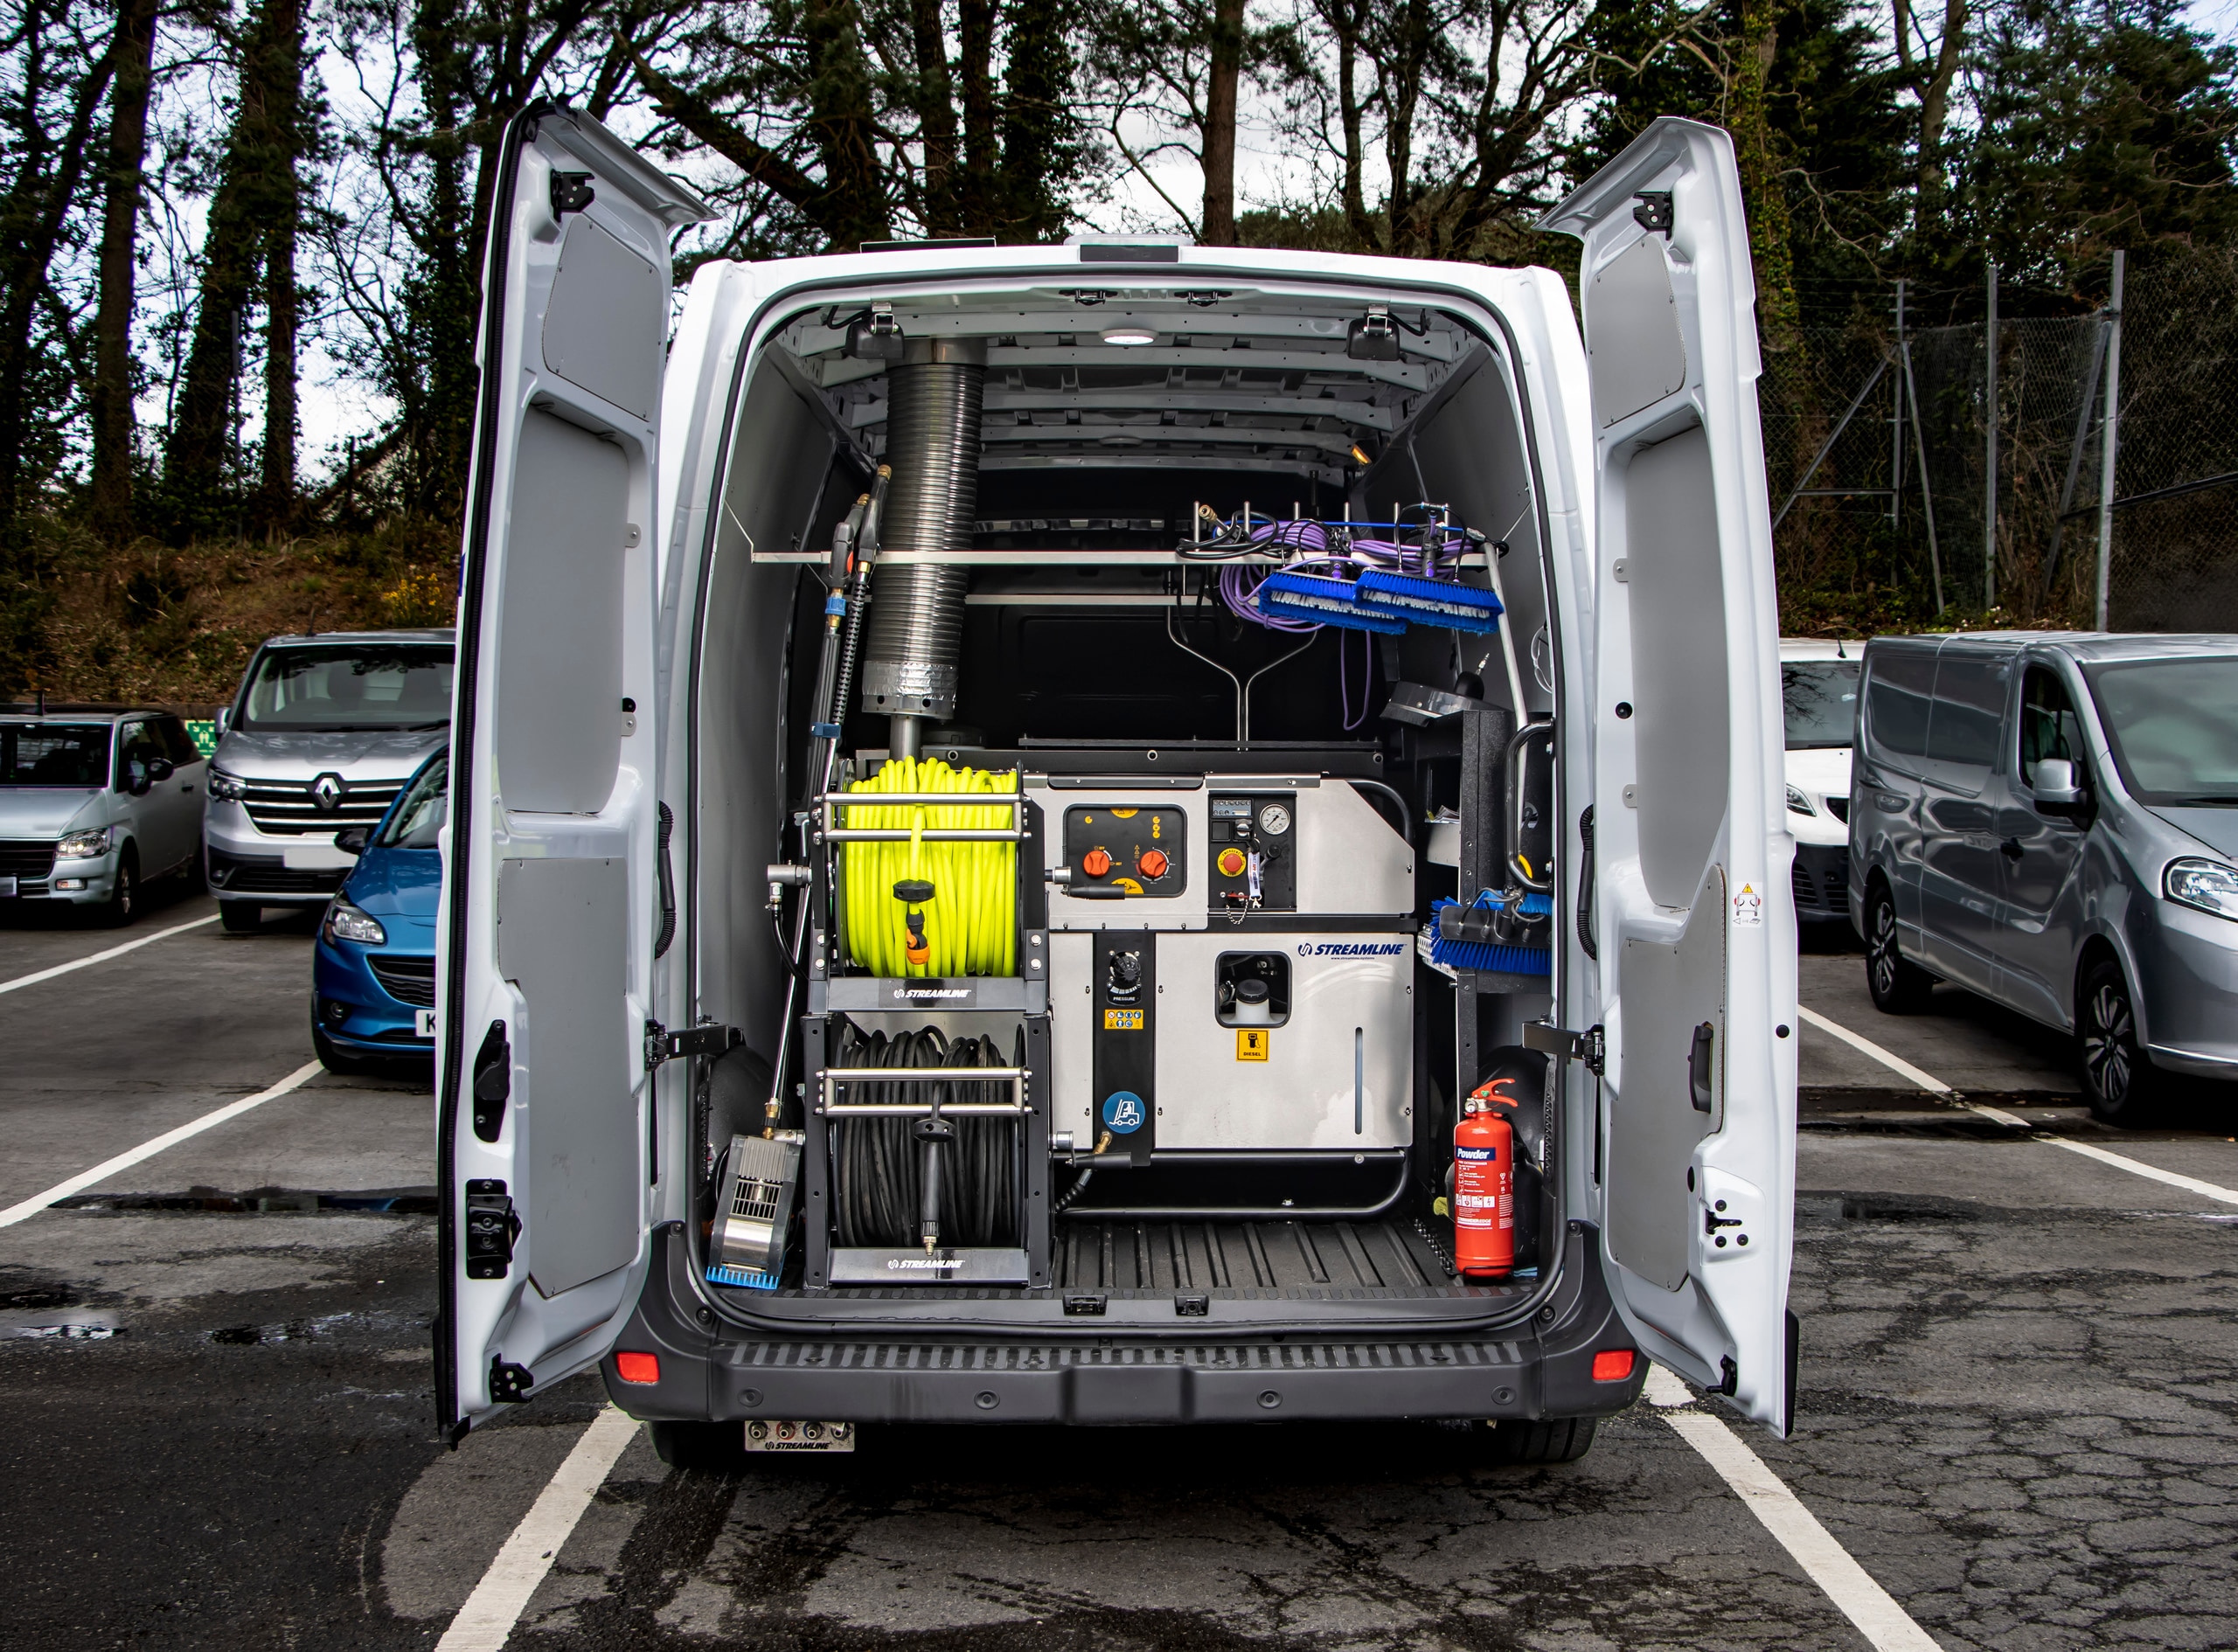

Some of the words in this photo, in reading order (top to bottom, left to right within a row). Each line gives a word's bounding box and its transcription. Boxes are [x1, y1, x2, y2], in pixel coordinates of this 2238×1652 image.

[1314, 943, 1405, 955] STREAMLINE
[905, 989, 970, 998] STREAMLINE
[1457, 1147, 1491, 1160] Powder
[899, 1260, 963, 1269] STREAMLINE
[775, 1441, 831, 1450] STREAMLINE
